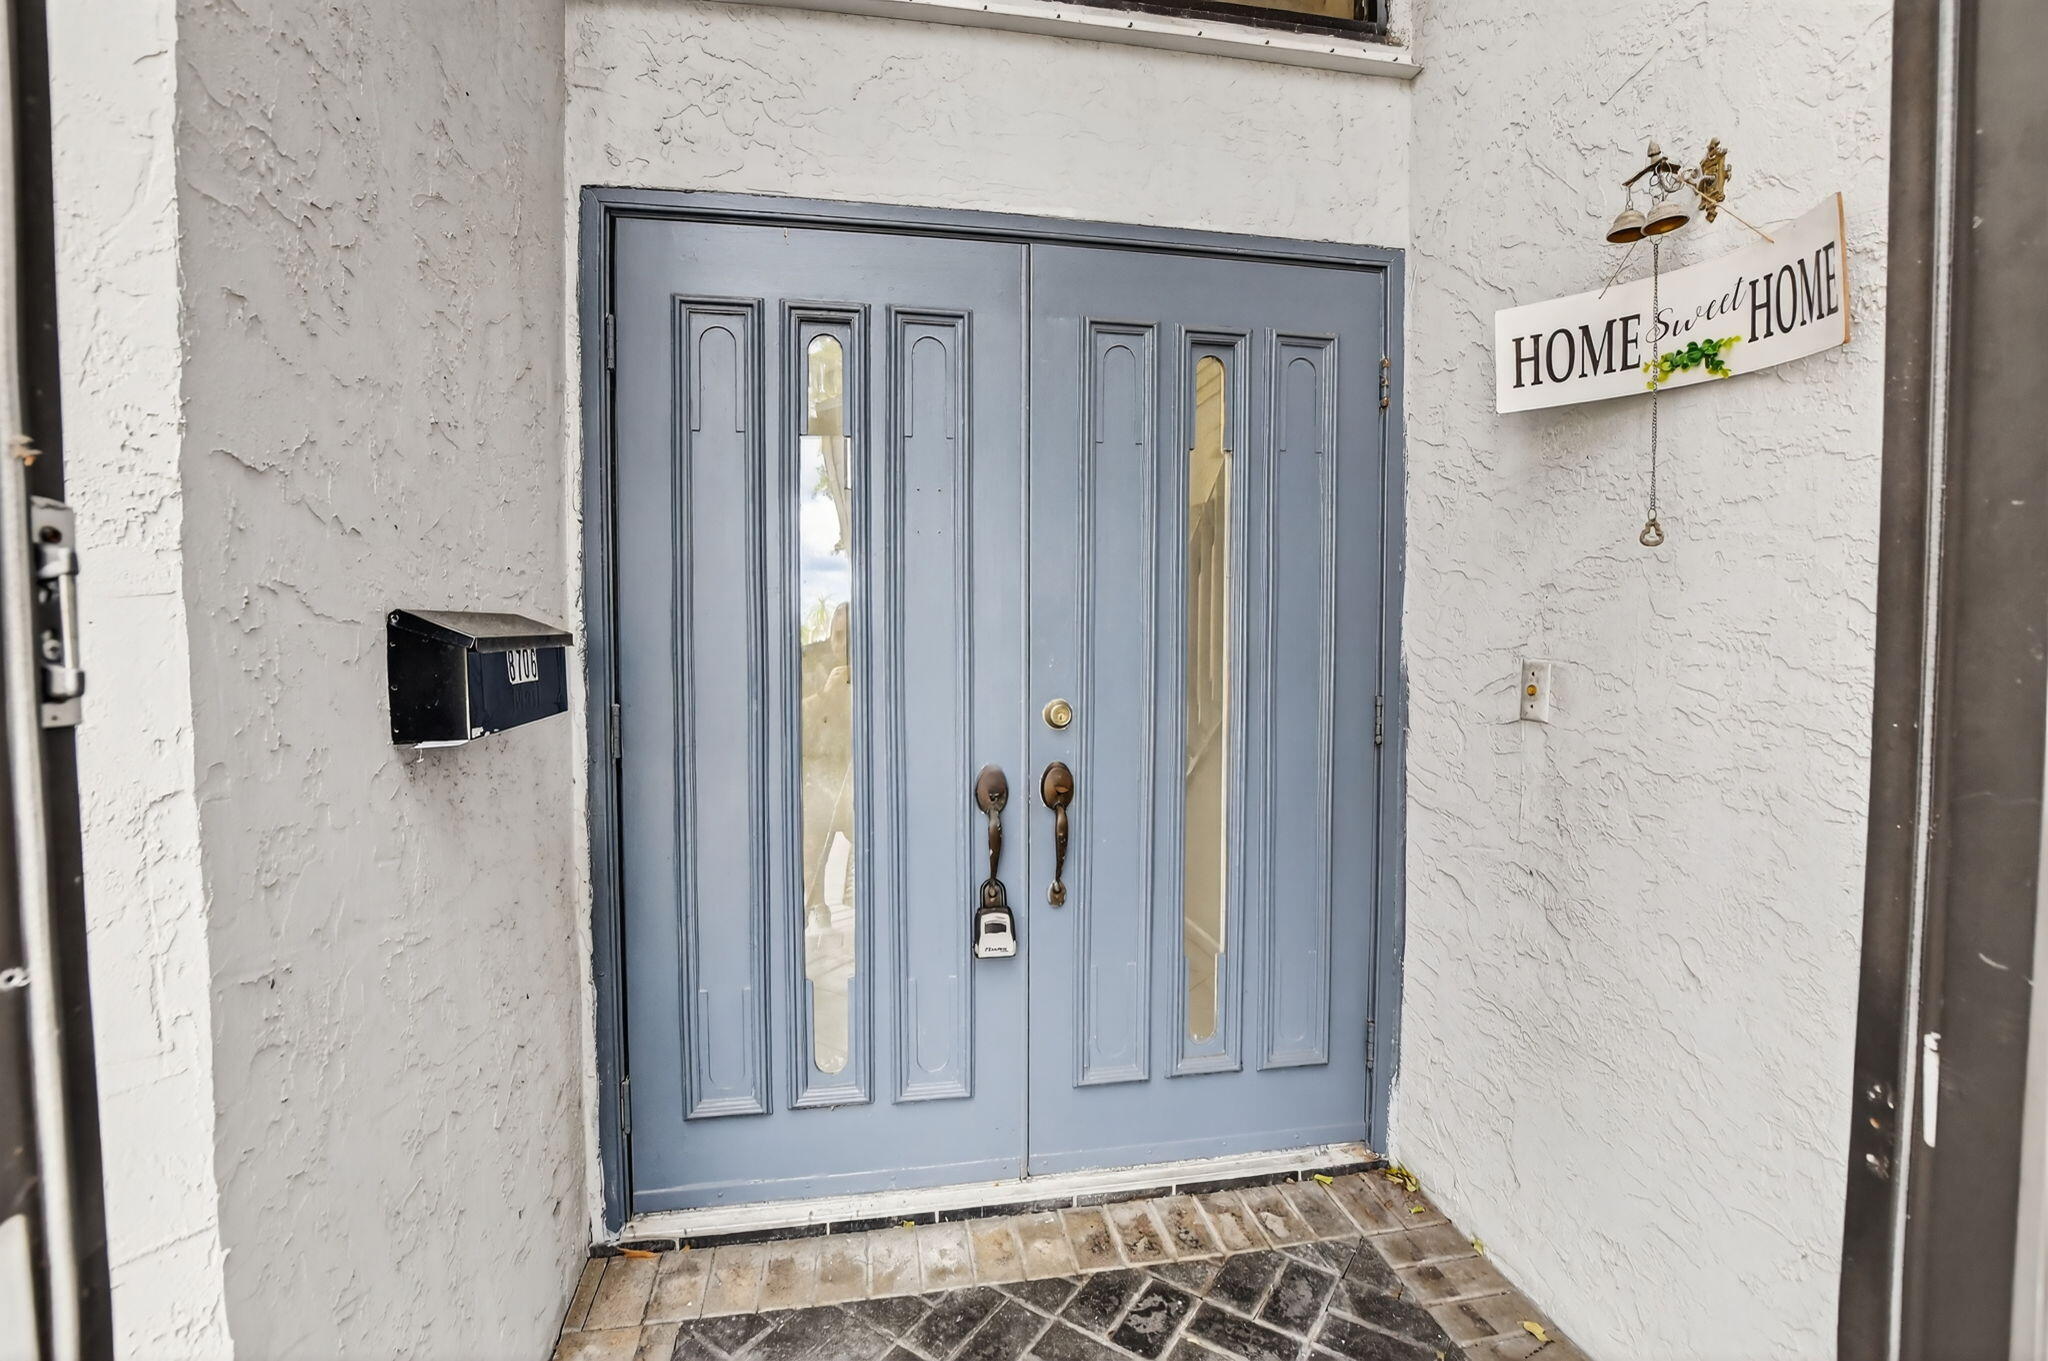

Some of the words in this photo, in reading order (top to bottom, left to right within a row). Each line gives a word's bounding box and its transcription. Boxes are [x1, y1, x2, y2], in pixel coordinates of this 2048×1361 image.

[1512, 314, 1642, 389] HOME
[1645, 276, 1747, 344] Sweet
[1748, 240, 1839, 343] HOME
[507, 648, 537, 682] 8706
